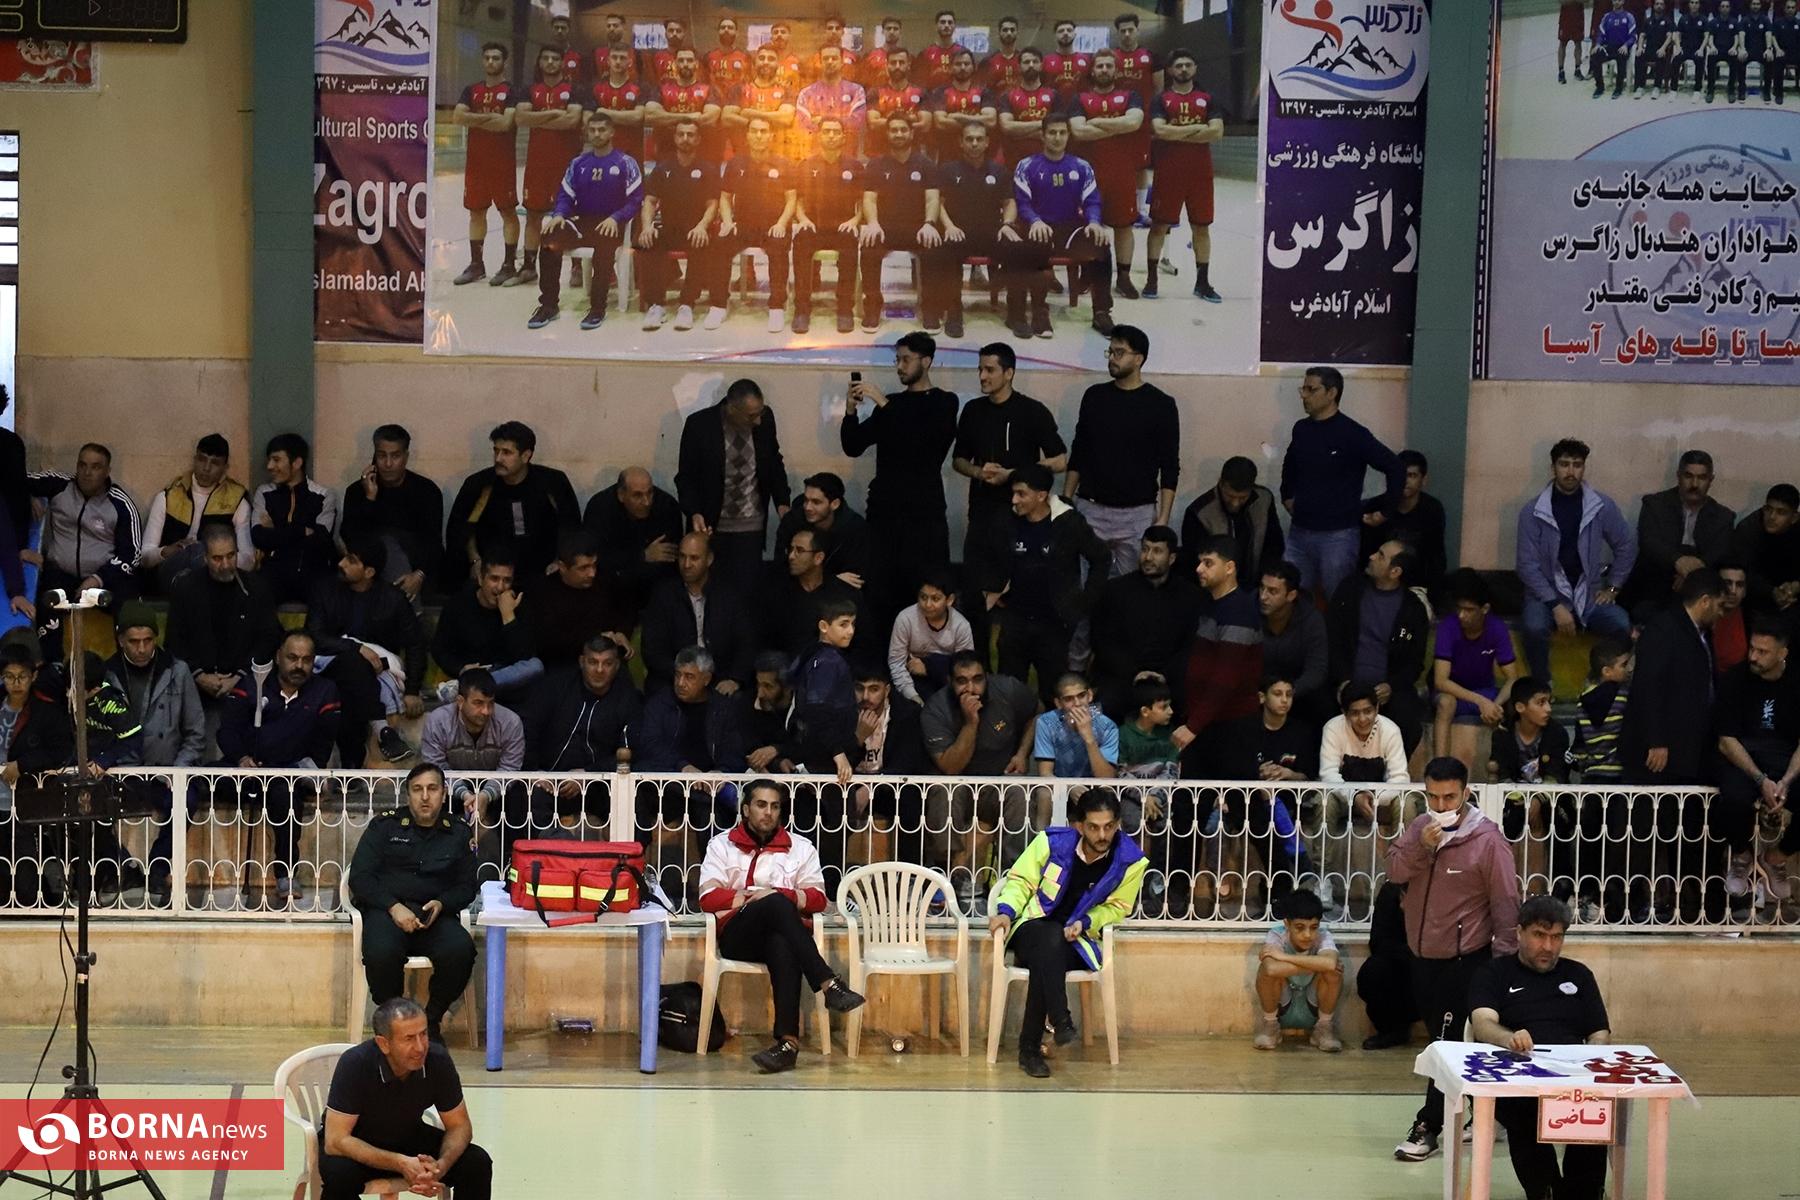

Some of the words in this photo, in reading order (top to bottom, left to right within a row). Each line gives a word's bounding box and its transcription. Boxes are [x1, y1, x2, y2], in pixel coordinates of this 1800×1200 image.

[1280, 102, 1307, 114] ۱۳۹۷
[1316, 103, 1345, 117] تاسیس
[1393, 105, 1417, 119] اسلام
[366, 116, 418, 144] Sports
[1268, 140, 1319, 169] ورزشی
[1322, 140, 1377, 169] فرهنگی
[1380, 143, 1424, 169] باشگاه
[1656, 179, 1705, 202] همه
[1709, 175, 1798, 208] حمایت
[1267, 188, 1418, 273] زاگرس
[1543, 226, 1620, 260] زاگرس
[1625, 225, 1700, 260] هندبال
[1705, 226, 1799, 262] هواداران
[1354, 291, 1392, 319] اسلام
[1584, 277, 1649, 312] مقتدر
[1654, 275, 1703, 312] فنی
[1706, 277, 1747, 313] کادر
[1573, 1089, 1583, 1103] B
[1548, 1107, 1607, 1130] قاضی
